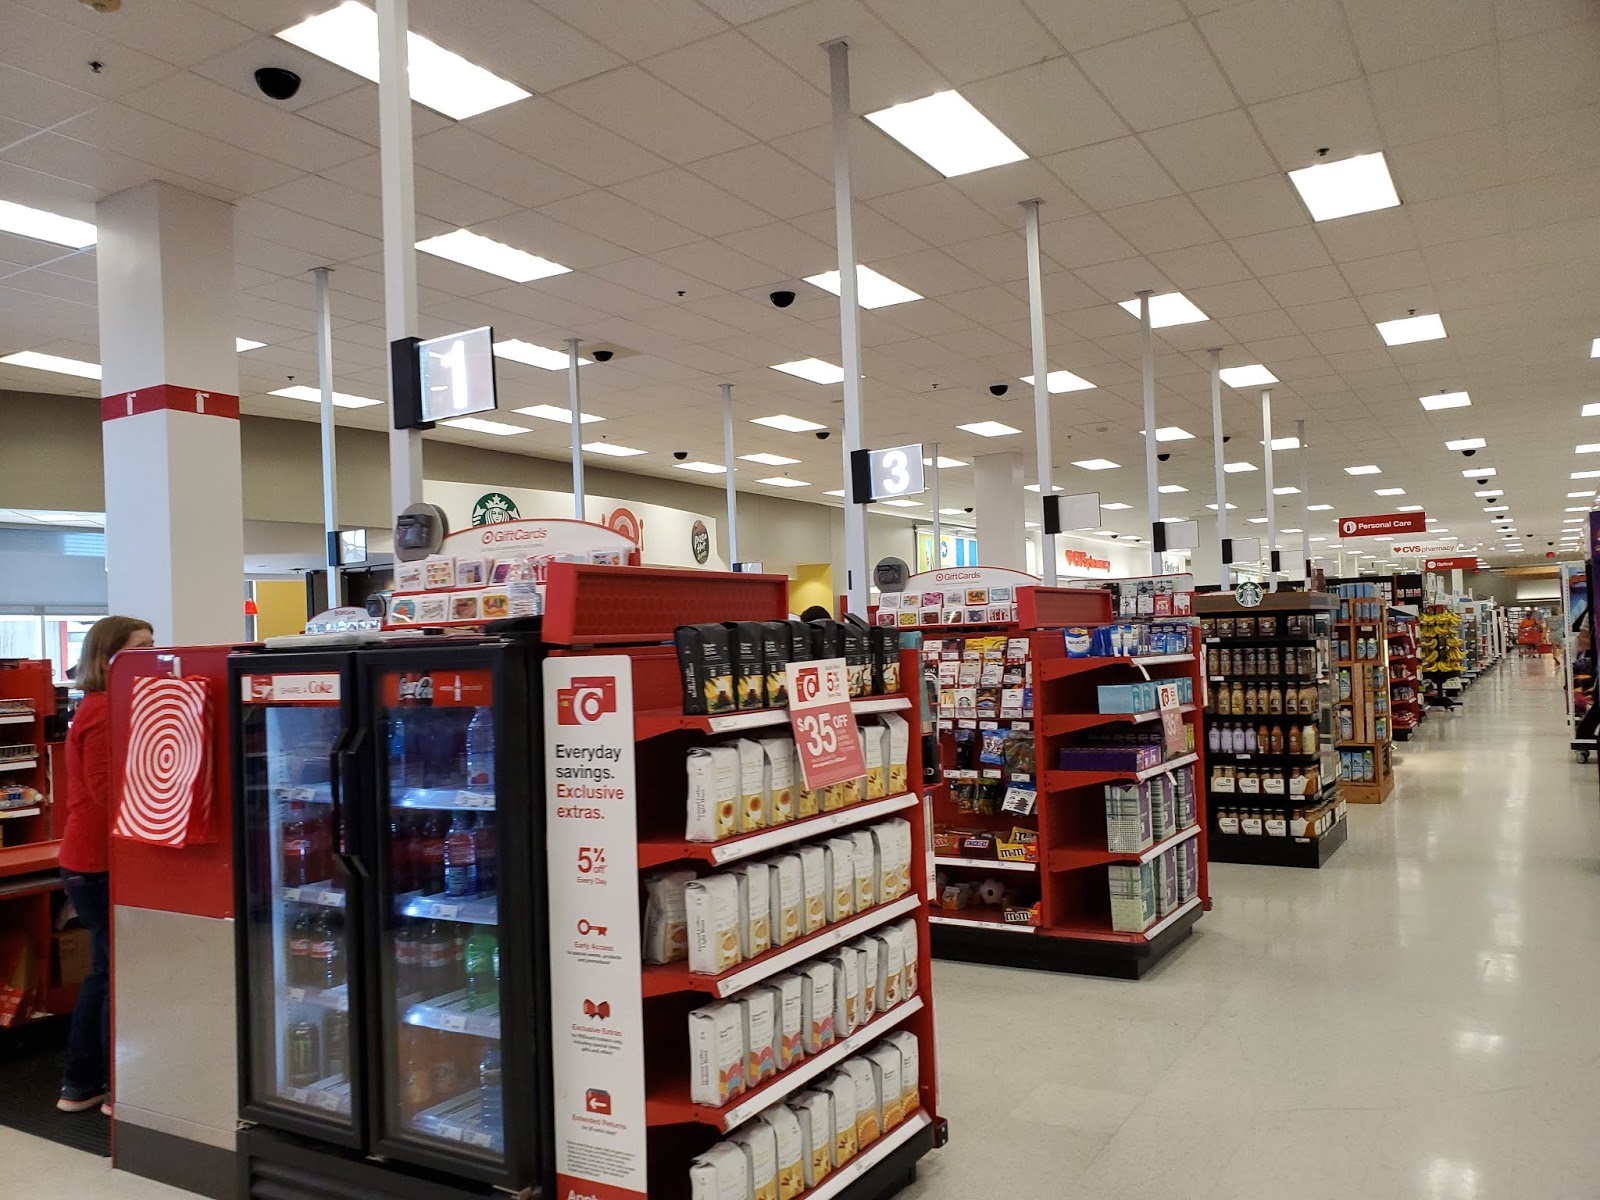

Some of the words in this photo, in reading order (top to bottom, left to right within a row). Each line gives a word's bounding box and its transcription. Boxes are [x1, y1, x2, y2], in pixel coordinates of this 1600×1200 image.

[439, 340, 469, 410] 1
[882, 450, 911, 493] 3
[1358, 521, 1391, 530] Personal
[495, 528, 548, 542] GiftCards
[1402, 545, 1421, 553] CVS
[1421, 545, 1455, 553] pharmacy
[944, 572, 981, 581] GiftCards
[308, 680, 334, 694] Coke
[797, 713, 838, 757] $35
[832, 714, 848, 729] OFF
[556, 744, 622, 762] Everyday
[556, 764, 615, 782] savings.
[556, 783, 625, 800] Exclusive
[557, 805, 605, 820] extras.
[578, 847, 606, 874] 5%
[574, 941, 590, 950] Early
